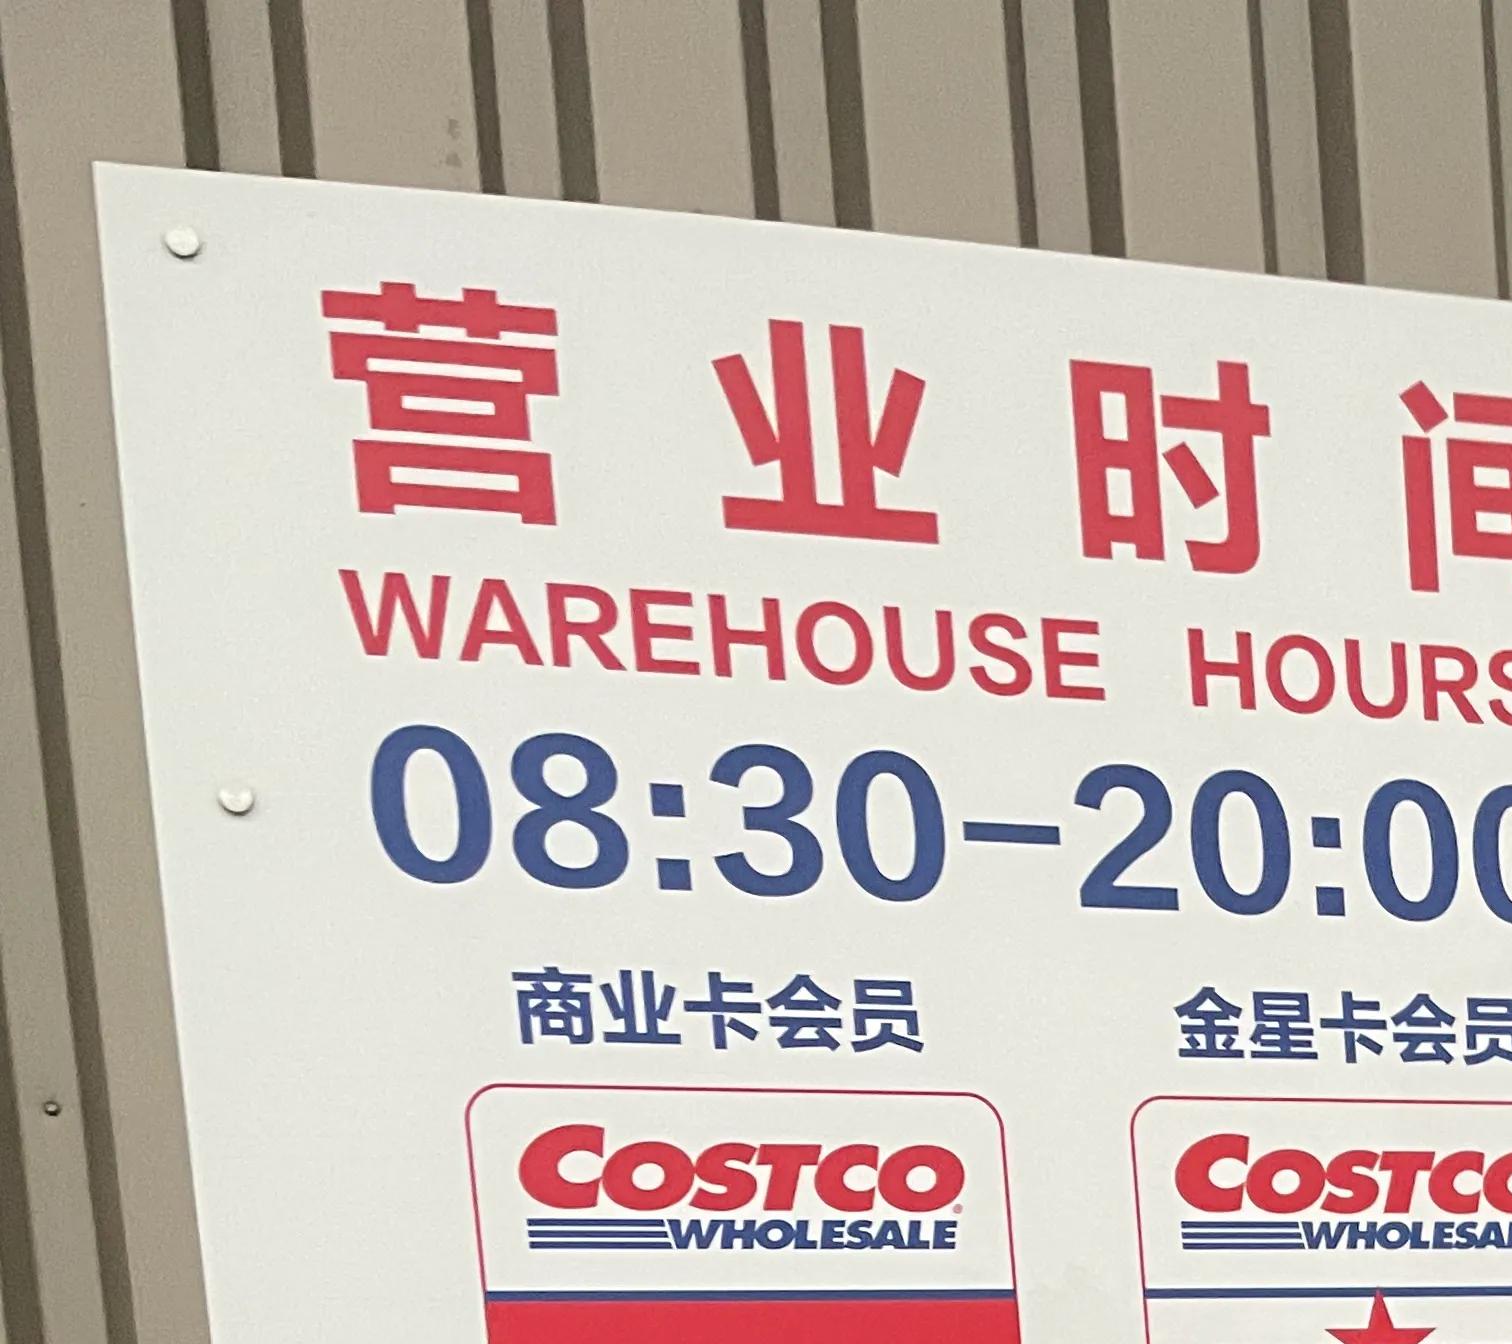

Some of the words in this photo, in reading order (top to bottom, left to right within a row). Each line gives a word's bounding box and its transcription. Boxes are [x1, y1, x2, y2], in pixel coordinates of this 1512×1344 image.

[340, 569, 1105, 700] WAREHOUSE
[512, 966, 925, 1053] 商业卡会员
[518, 1123, 965, 1213] COSTCO
[667, 1219, 958, 1250] WHOLESALE
